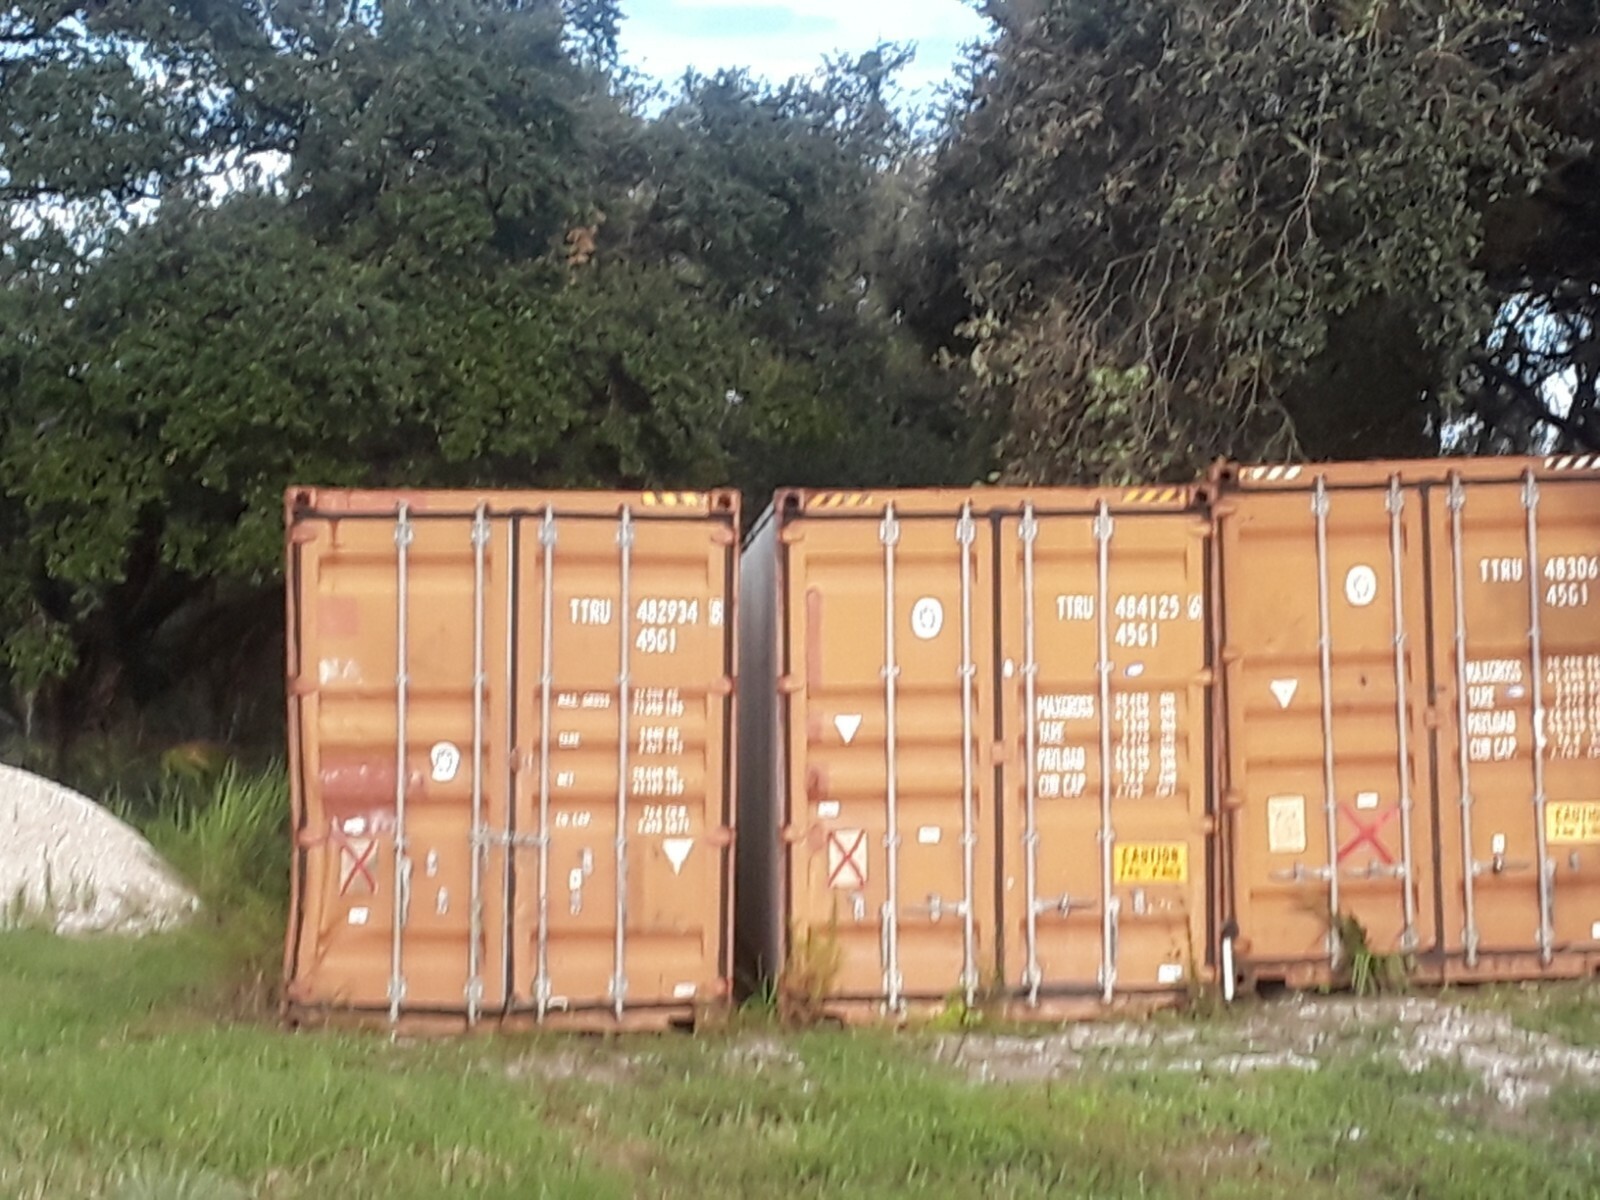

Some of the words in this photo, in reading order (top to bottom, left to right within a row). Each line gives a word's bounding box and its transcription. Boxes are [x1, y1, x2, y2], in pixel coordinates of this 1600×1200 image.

[1480, 558, 1523, 583] TTRU
[1544, 556, 1599, 582] 48306
[570, 598, 611, 625] TTRU
[636, 598, 698, 625] 482934
[1057, 595, 1093, 620] TTRU
[1115, 595, 1180, 620] 484125
[1187, 594, 1202, 621] 6
[1121, 847, 1178, 864] CAUTION
